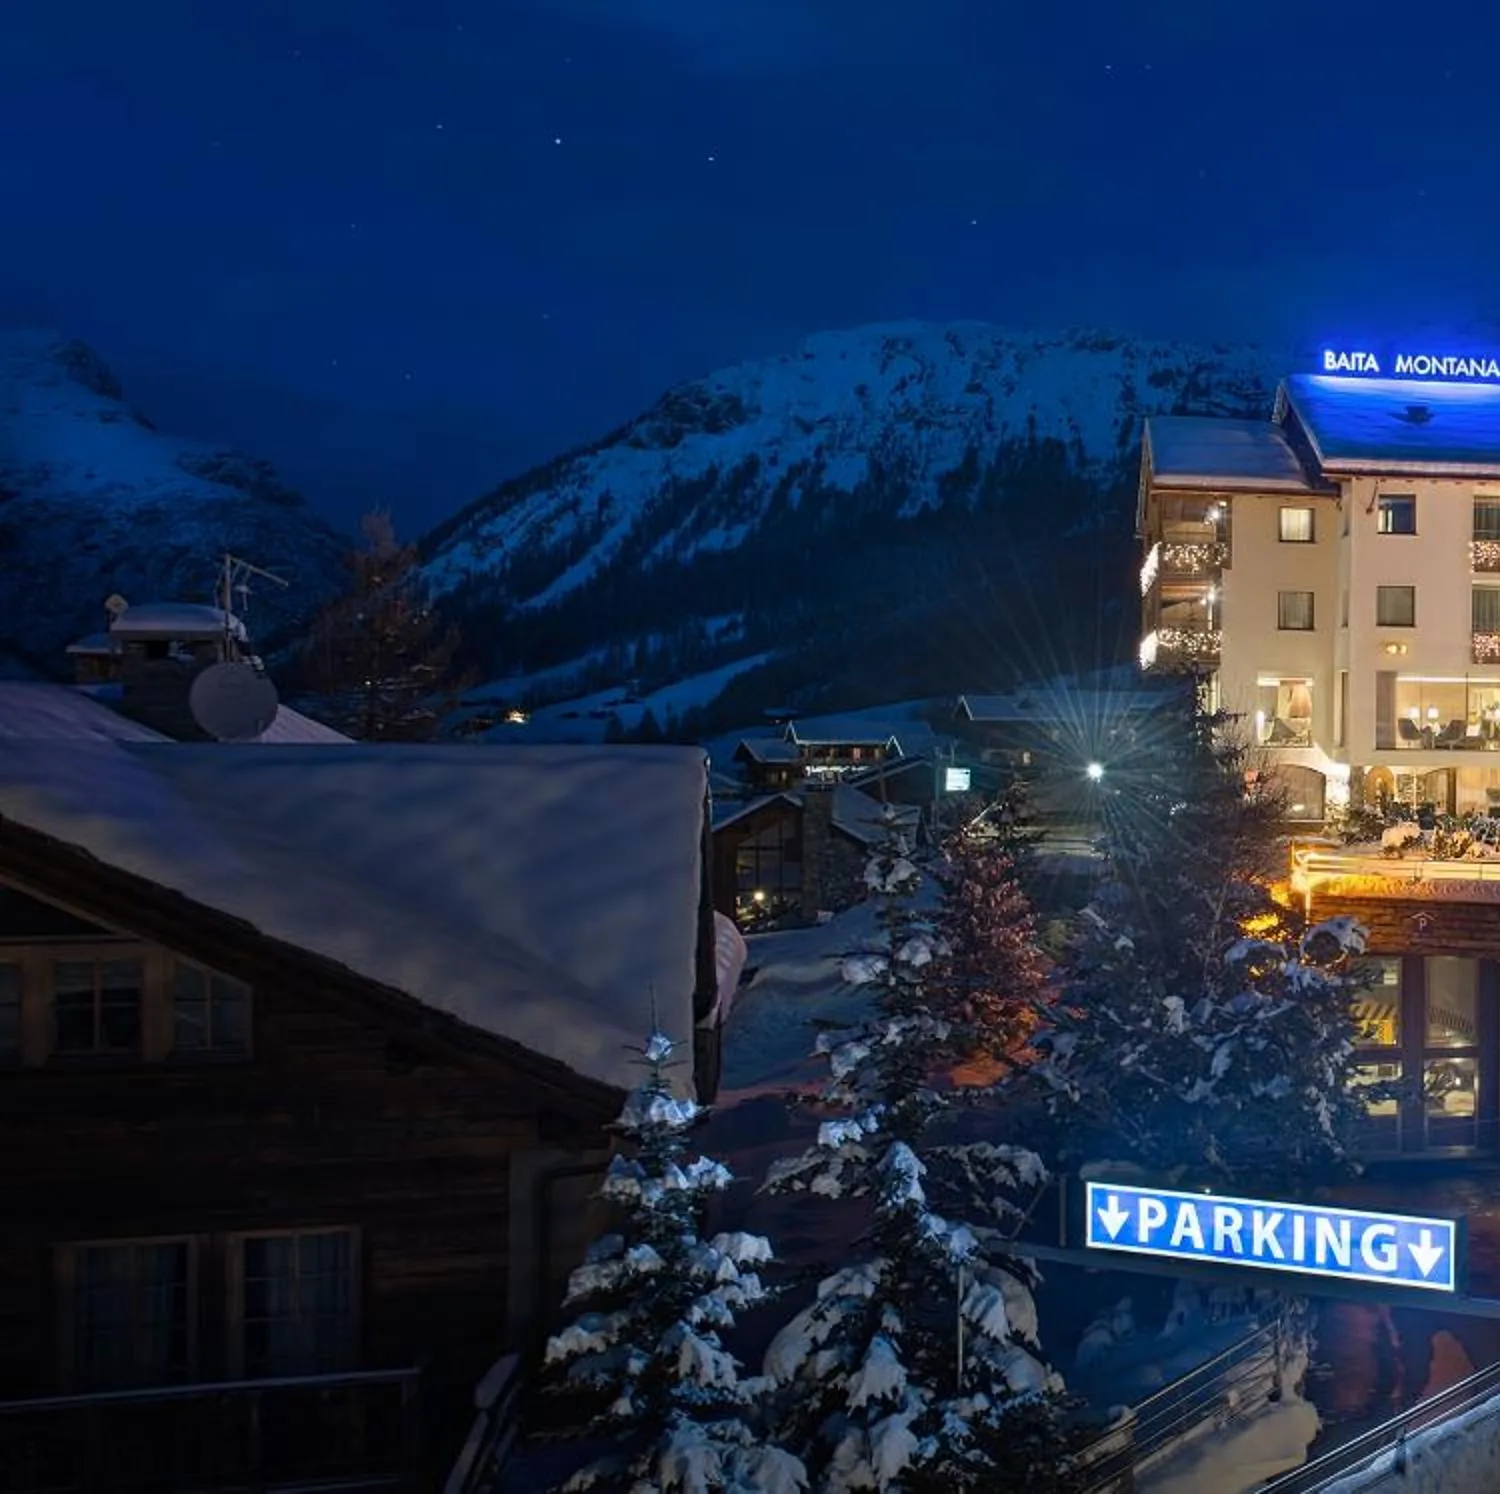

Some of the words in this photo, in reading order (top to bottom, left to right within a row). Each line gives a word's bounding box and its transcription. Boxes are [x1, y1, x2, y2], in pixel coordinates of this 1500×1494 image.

[1323, 350, 1380, 372] BAITA
[1395, 354, 1500, 377] MONTANA
[1137, 1196, 1399, 1272] PARKING
